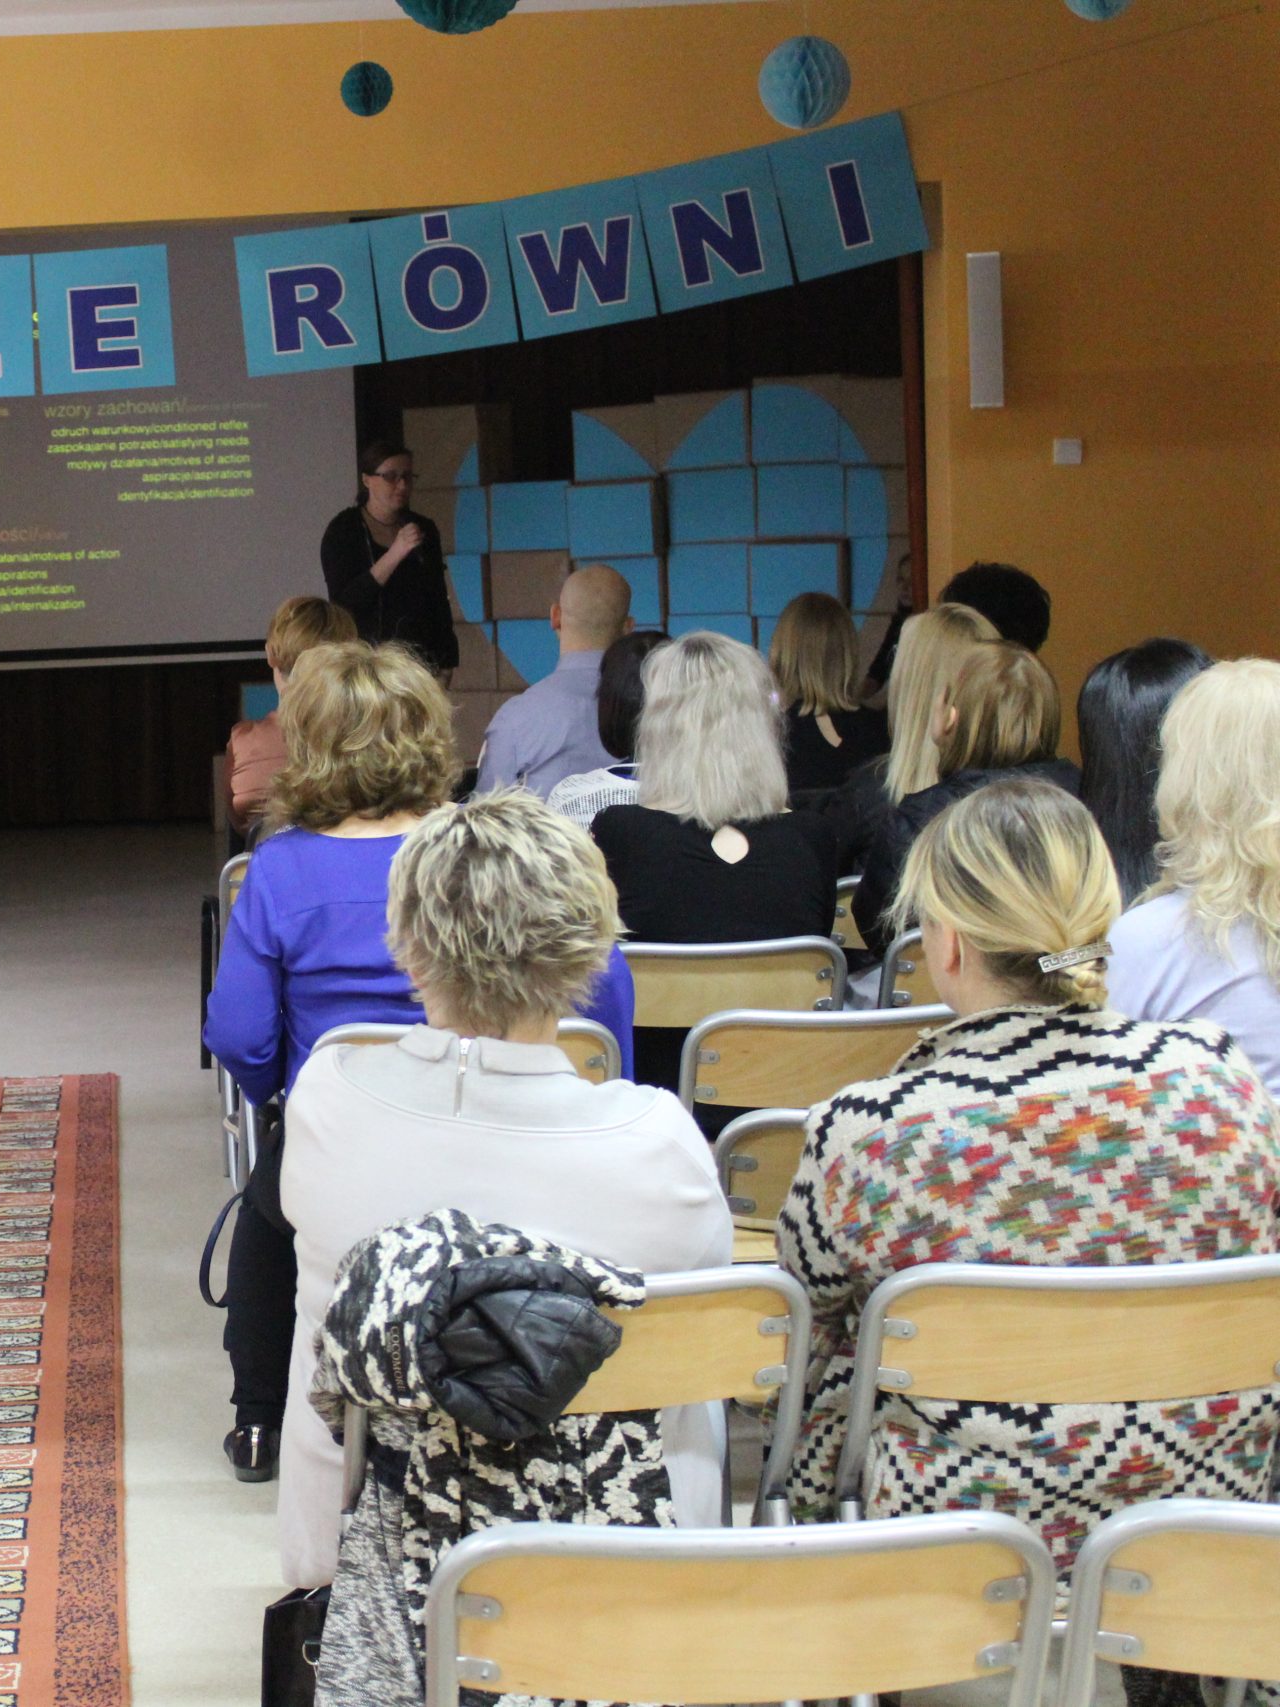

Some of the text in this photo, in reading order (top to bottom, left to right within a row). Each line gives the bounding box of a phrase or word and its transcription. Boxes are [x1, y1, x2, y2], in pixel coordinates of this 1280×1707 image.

[44, 403, 92, 420] wzory
[51, 426, 89, 438] odruch
[219, 419, 248, 430] reflex
[215, 435, 249, 447] needs
[67, 459, 107, 471] motywy
[204, 454, 214, 465] of
[217, 453, 251, 464] action
[75, 550, 86, 560] of
[88, 549, 121, 560] action
